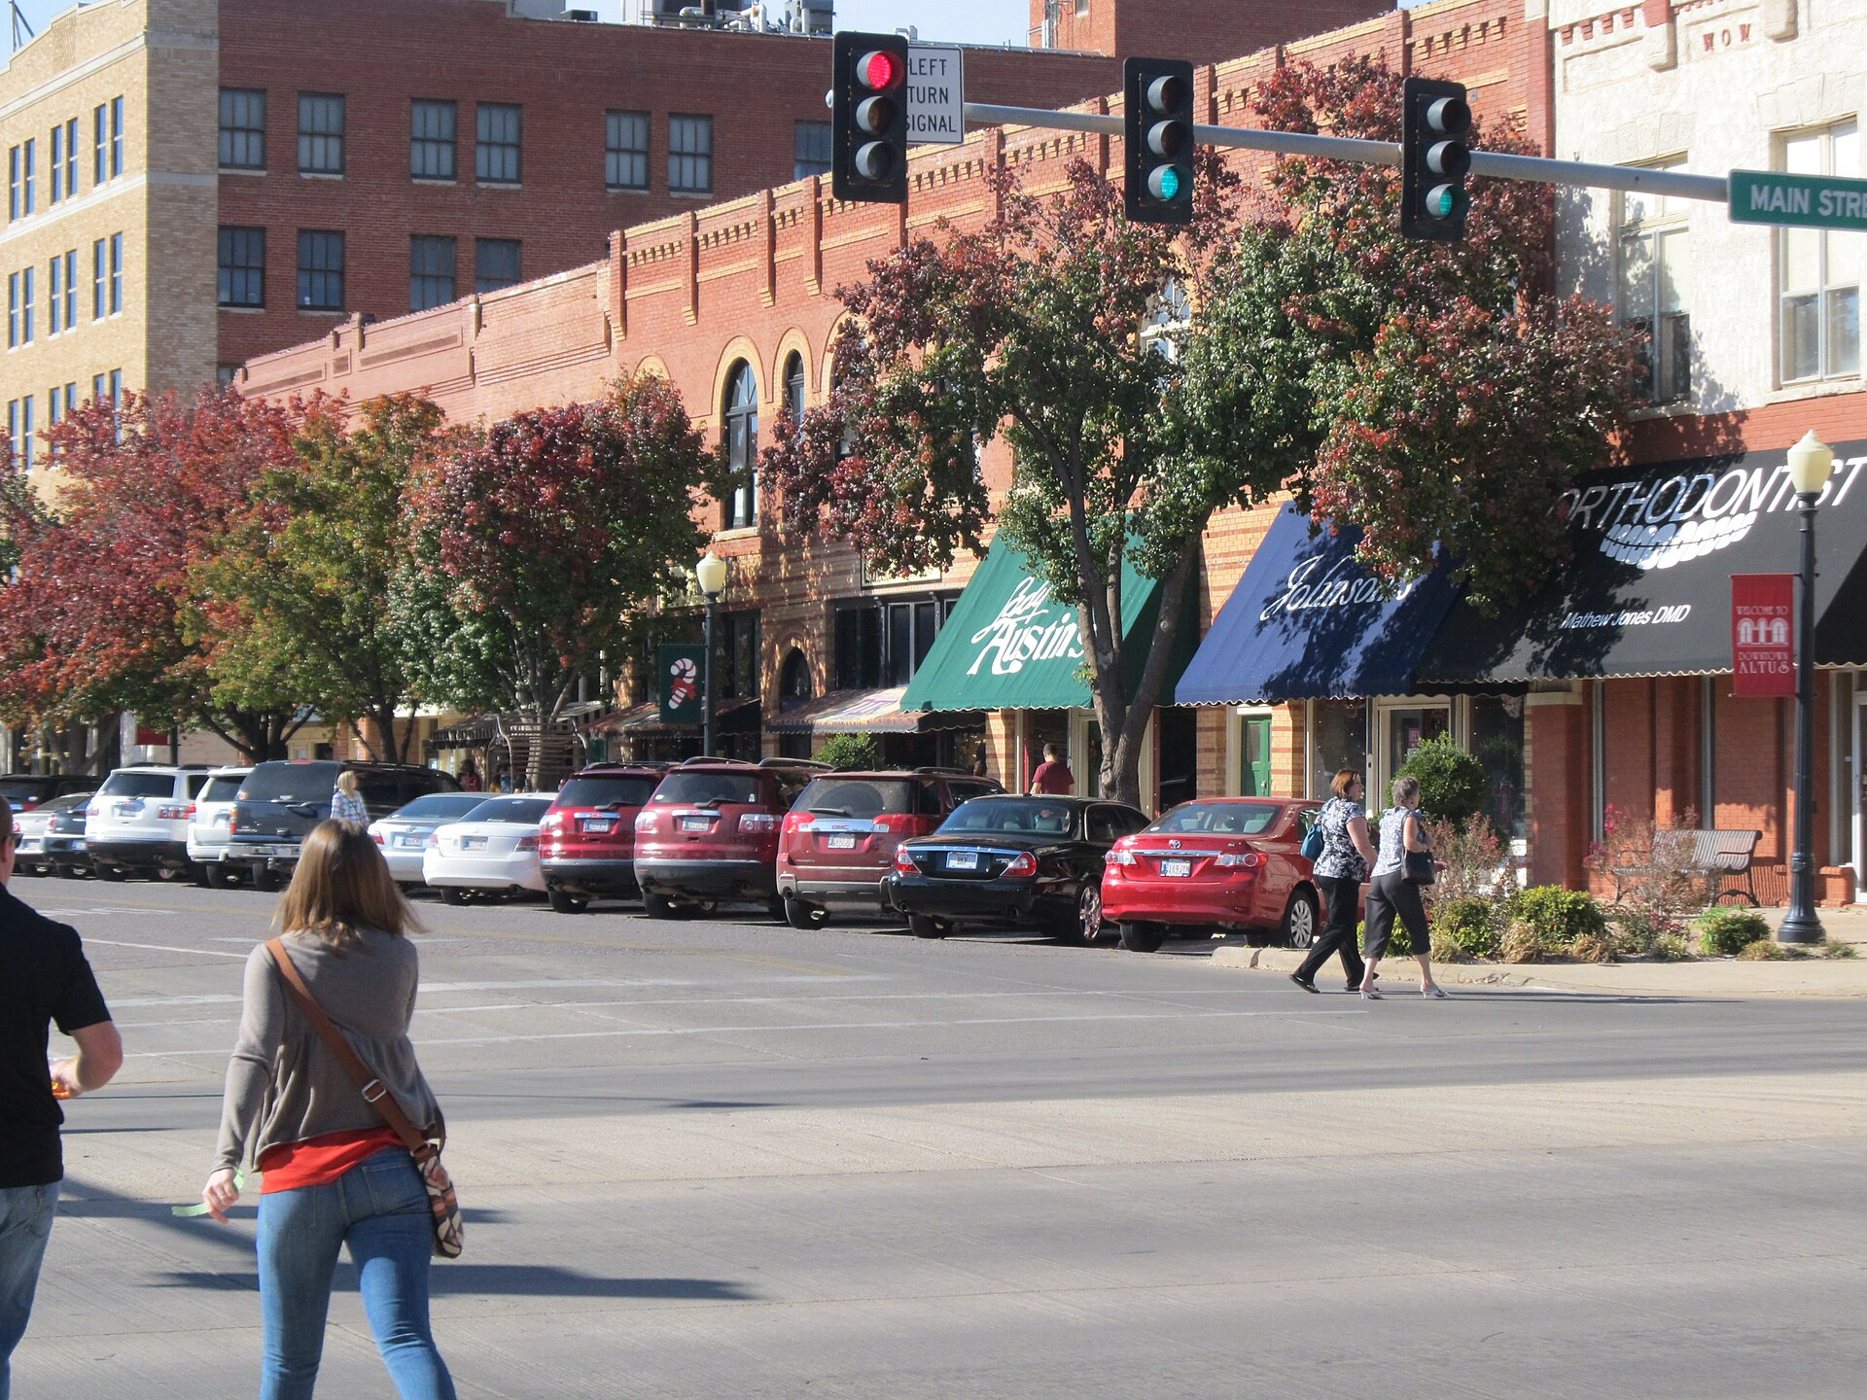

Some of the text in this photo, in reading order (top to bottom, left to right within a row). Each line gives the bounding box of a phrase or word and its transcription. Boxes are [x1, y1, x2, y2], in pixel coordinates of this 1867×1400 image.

[909, 58, 947, 76] LEFT
[907, 86, 949, 104] TURN
[906, 114, 957, 133] SIGNAL
[1750, 184, 1810, 214] MAIN
[1545, 457, 1867, 530] ORTHODONTST
[1560, 604, 1692, 629] Mathew Jones DMD
[1736, 605, 1789, 615] WELCOME TO
[1739, 661, 1790, 674] ALTUS
